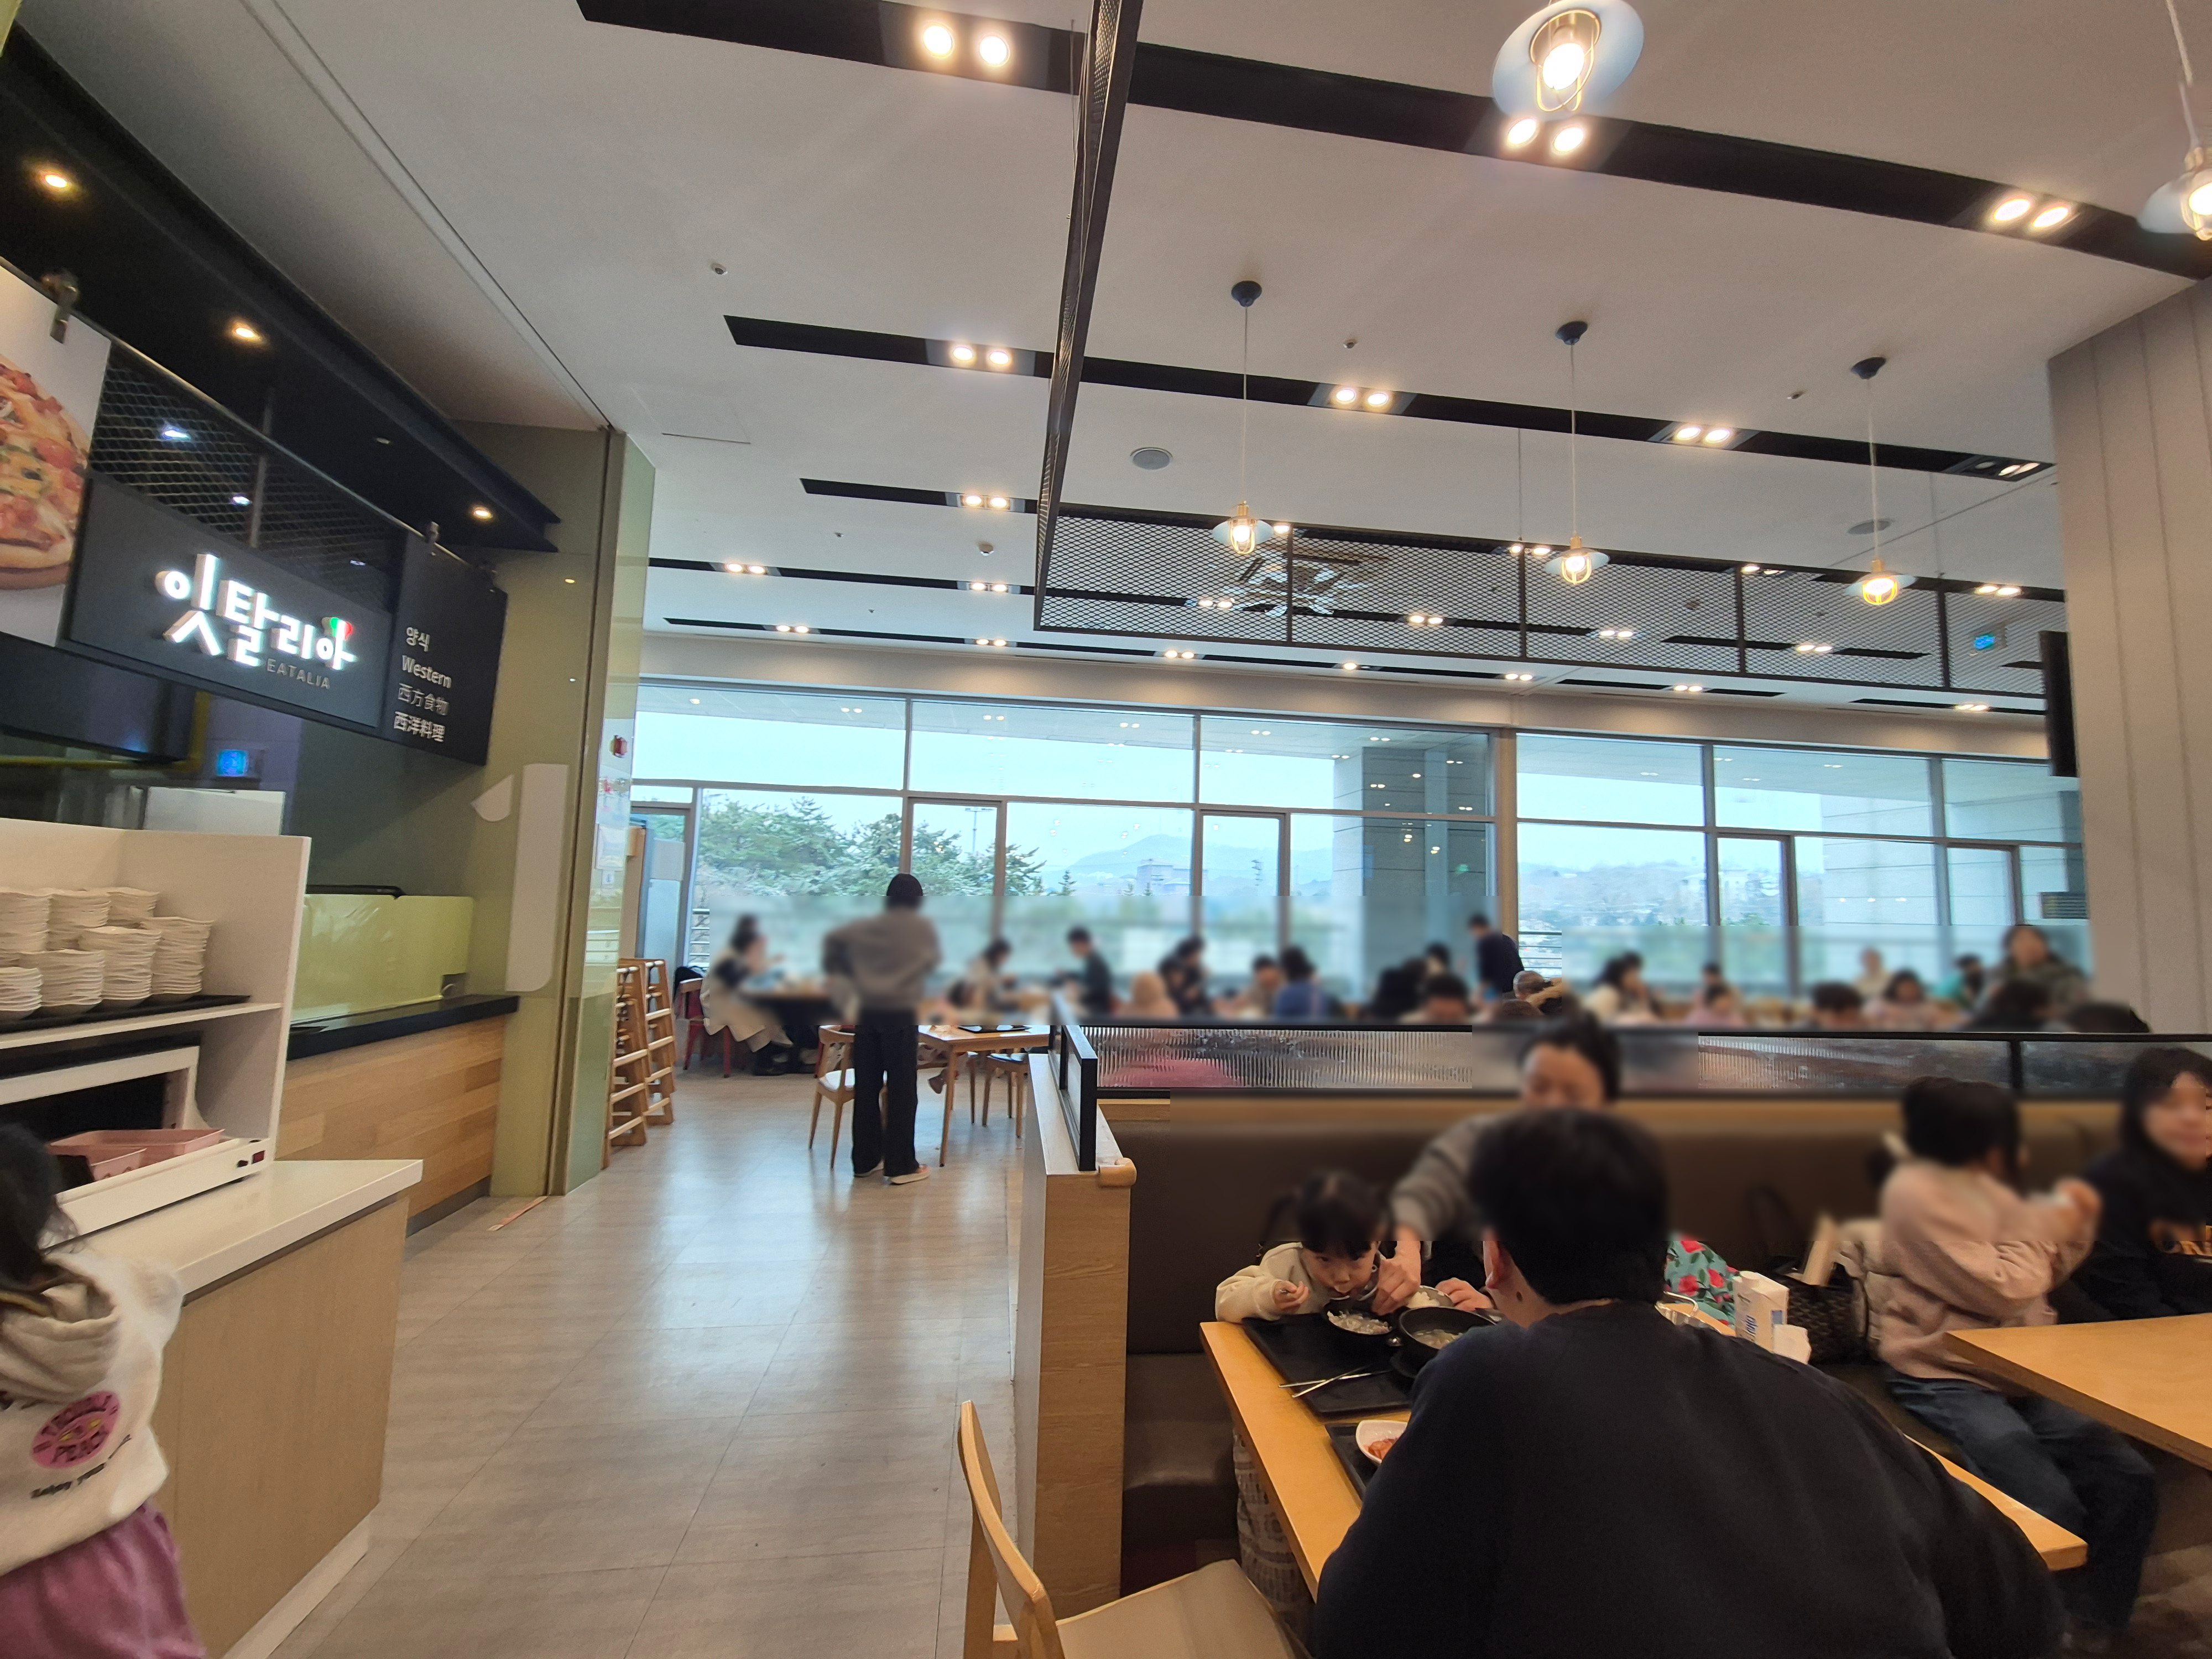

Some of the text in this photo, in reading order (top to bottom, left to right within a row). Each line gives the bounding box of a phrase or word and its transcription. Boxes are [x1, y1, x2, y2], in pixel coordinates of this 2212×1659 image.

[156, 554, 358, 670] 잇탈리아
[406, 627, 430, 652] 양식
[267, 658, 331, 690] EATALIA
[401, 655, 452, 688] Western
[398, 683, 450, 716] 西方食物
[393, 711, 446, 742] 西洋料理
